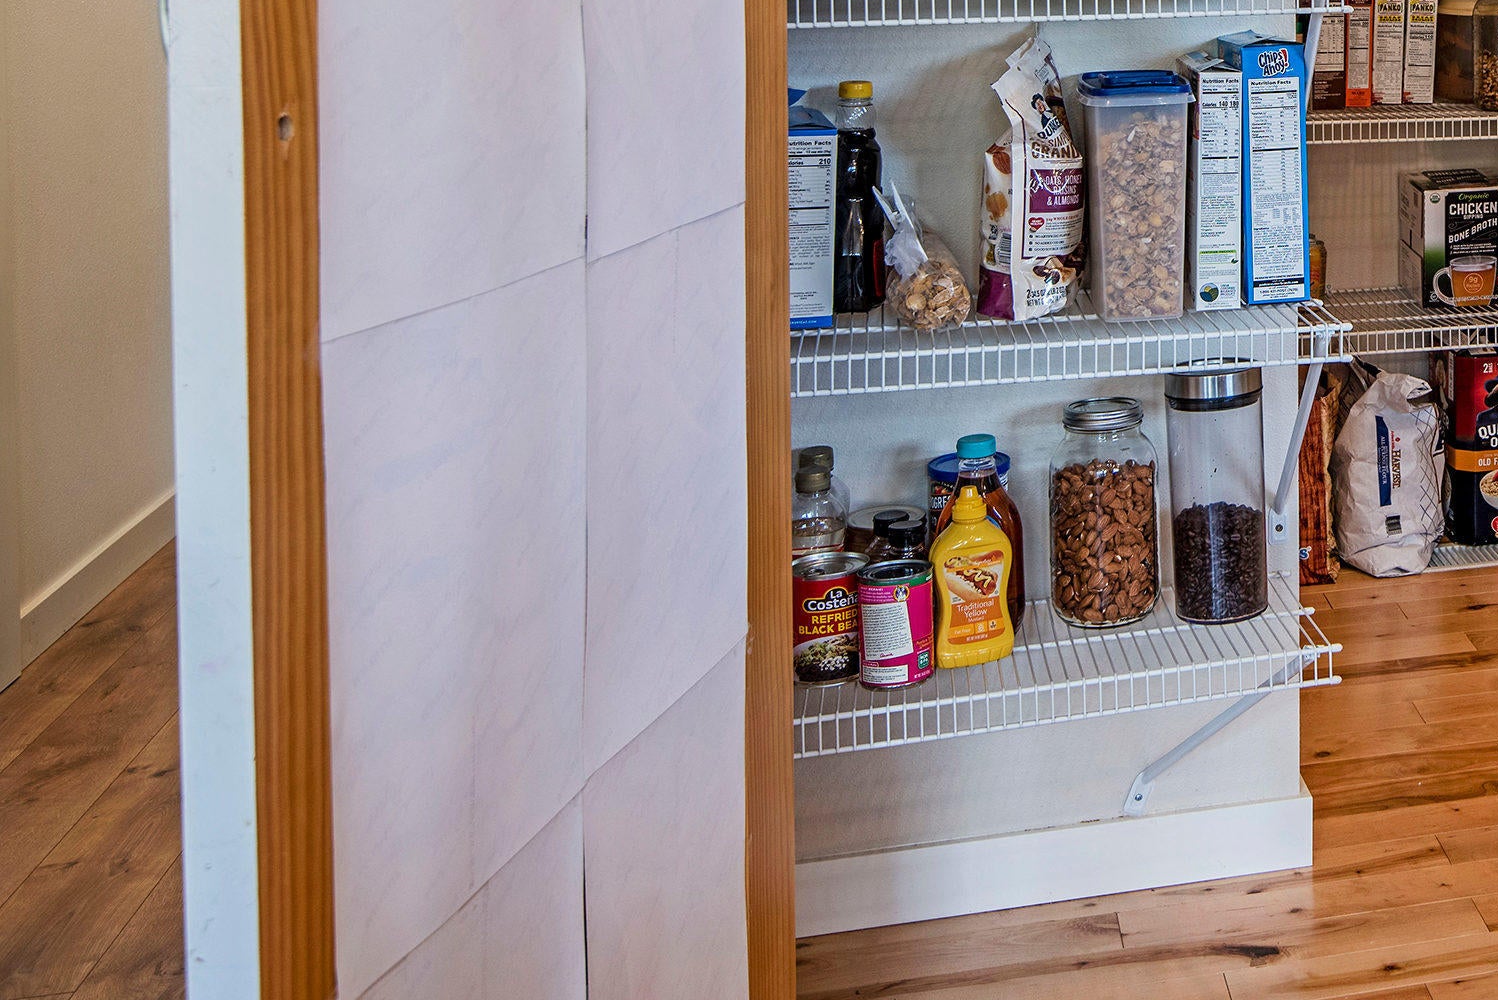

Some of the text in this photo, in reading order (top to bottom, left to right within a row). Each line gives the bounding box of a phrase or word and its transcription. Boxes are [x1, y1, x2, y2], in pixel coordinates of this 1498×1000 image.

[1380, 3, 1401, 12] PANKO
[1412, 3, 1434, 12] PANKO
[1258, 51, 1283, 67] Chips
[1046, 196, 1052, 206] &
[1458, 193, 1490, 202] Organic
[1449, 201, 1498, 216] CHICKEN
[1448, 217, 1498, 243] BONE BROTH
[1483, 363, 1489, 373] 2
[1478, 457, 1491, 466] OLD
[830, 589, 843, 600] La
[957, 598, 995, 612] Traditional
[811, 608, 858, 625] REFRIED
[964, 608, 988, 619] Yellow
[798, 620, 858, 635] BLACK BEA
